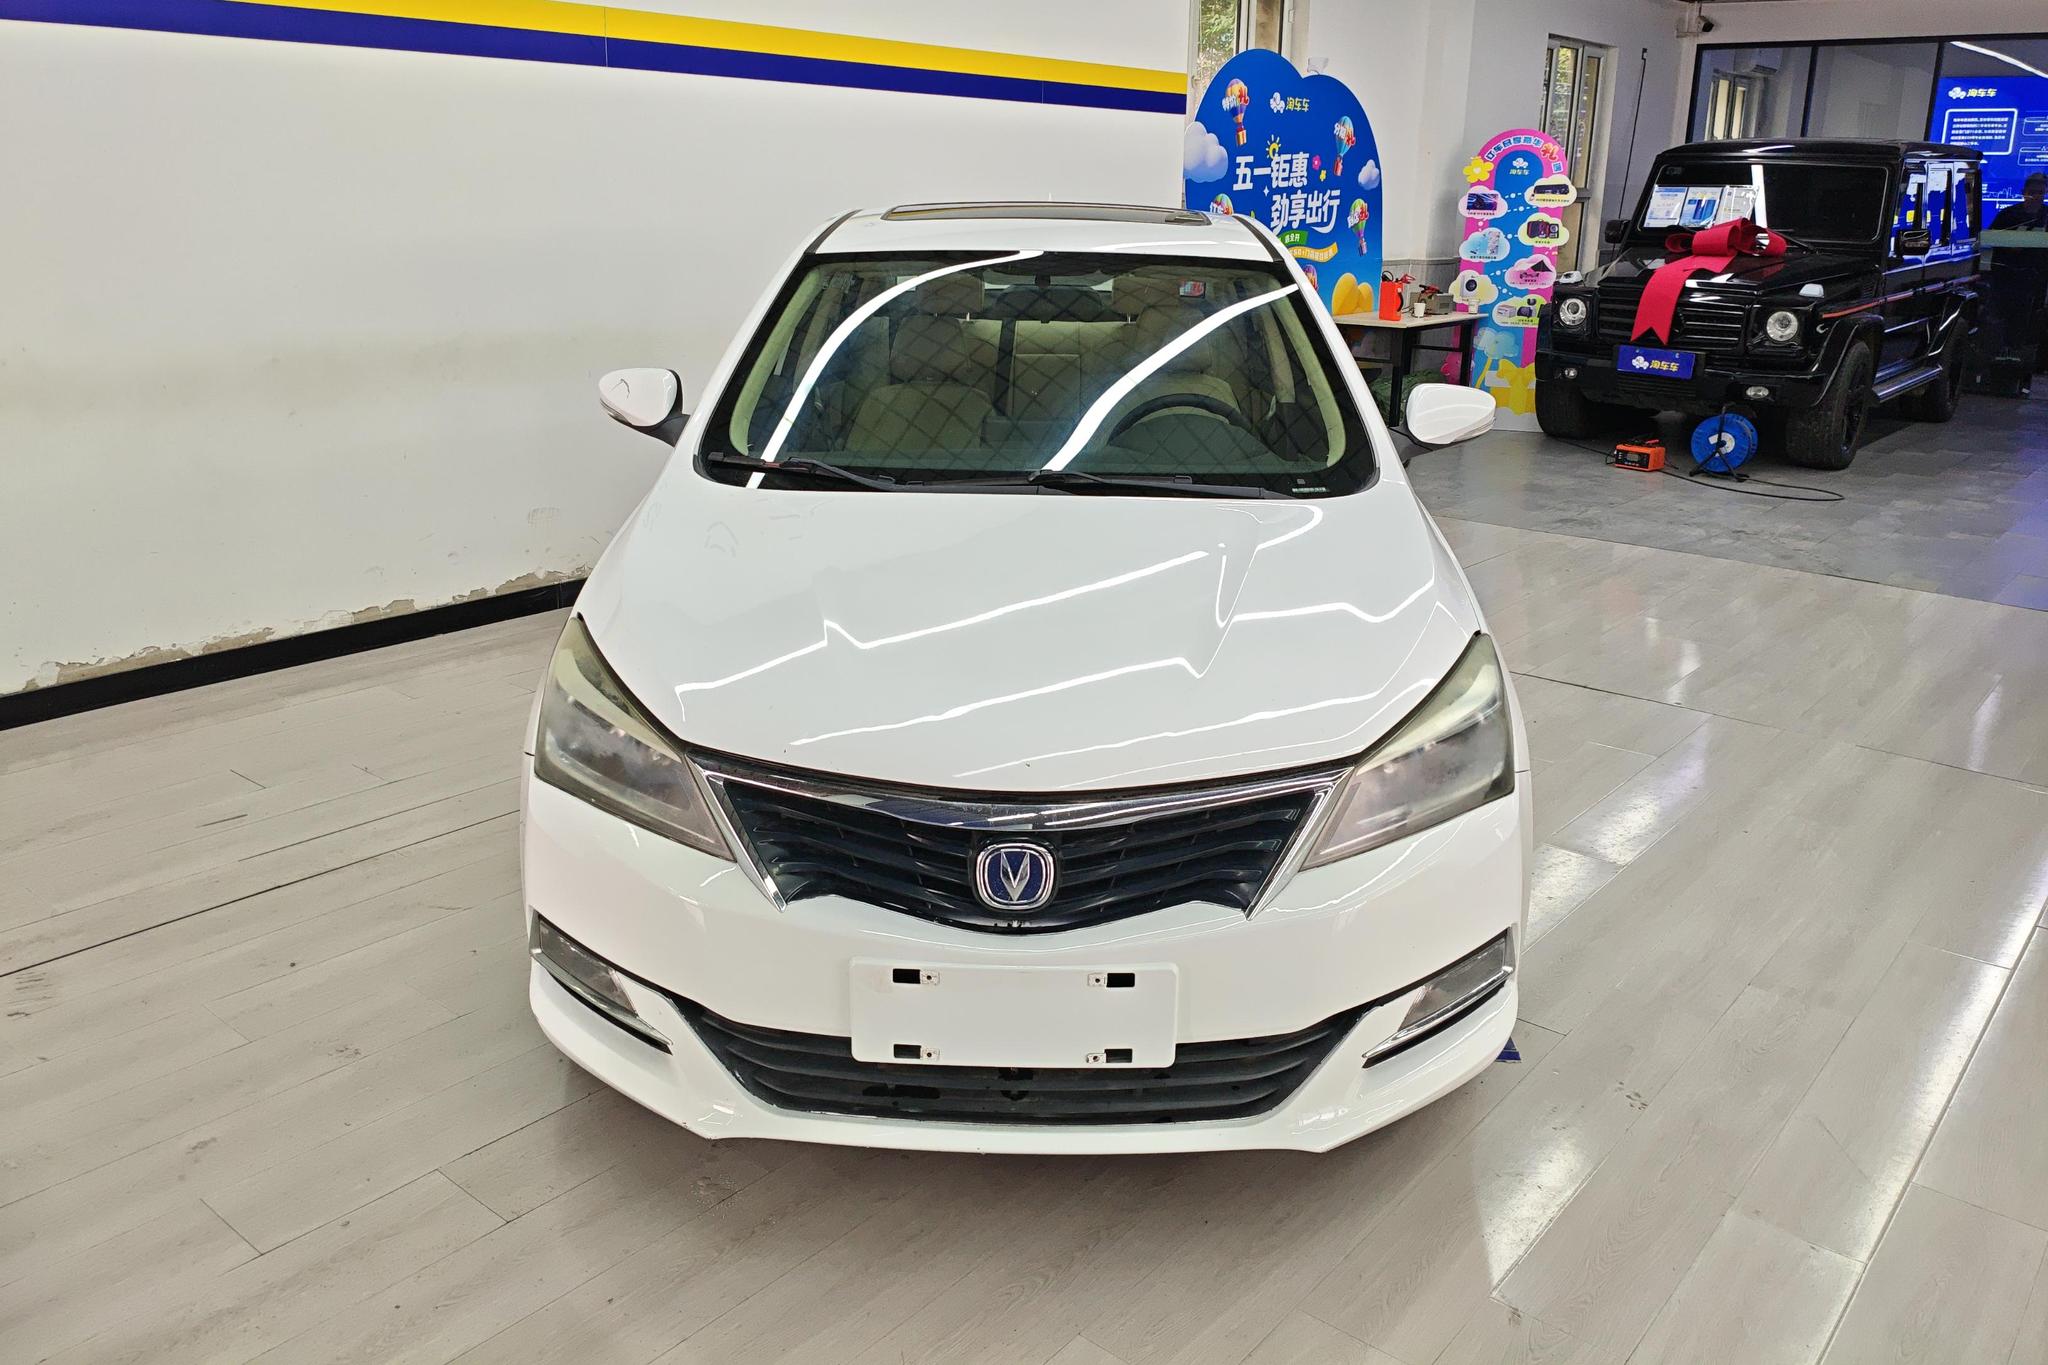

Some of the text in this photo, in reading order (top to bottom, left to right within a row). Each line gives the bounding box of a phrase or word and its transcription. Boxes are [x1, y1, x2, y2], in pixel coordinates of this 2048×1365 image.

[1967, 88, 1998, 98] 淘车车
[1286, 96, 1310, 112] 淘车车
[1232, 151, 1310, 191] 五一钜惠
[1270, 189, 1341, 234] 劲享出行
[1649, 360, 1680, 372] 淘车车
